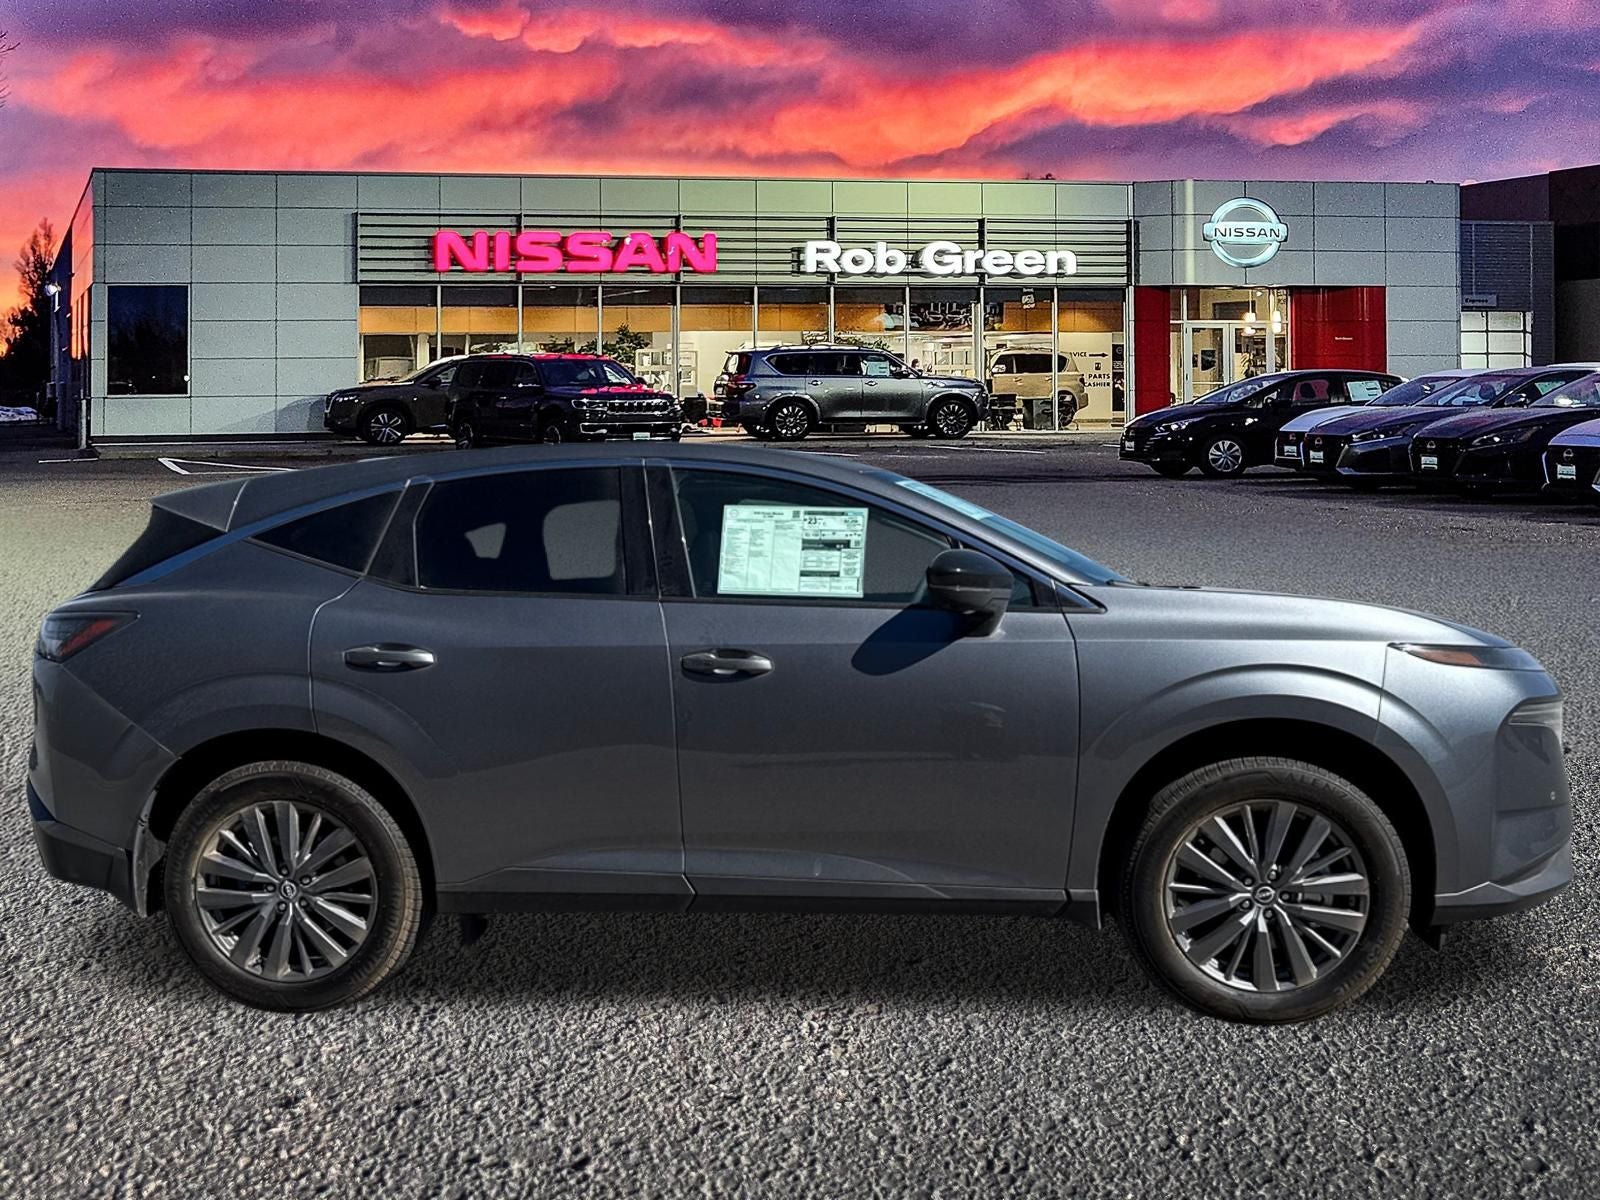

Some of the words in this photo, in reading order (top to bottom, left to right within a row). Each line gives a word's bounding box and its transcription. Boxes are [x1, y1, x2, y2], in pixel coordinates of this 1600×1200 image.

[1214, 227, 1280, 238] NISSAN
[434, 230, 718, 273] NISSAN
[804, 240, 907, 274] Rob
[922, 241, 1077, 275] Green
